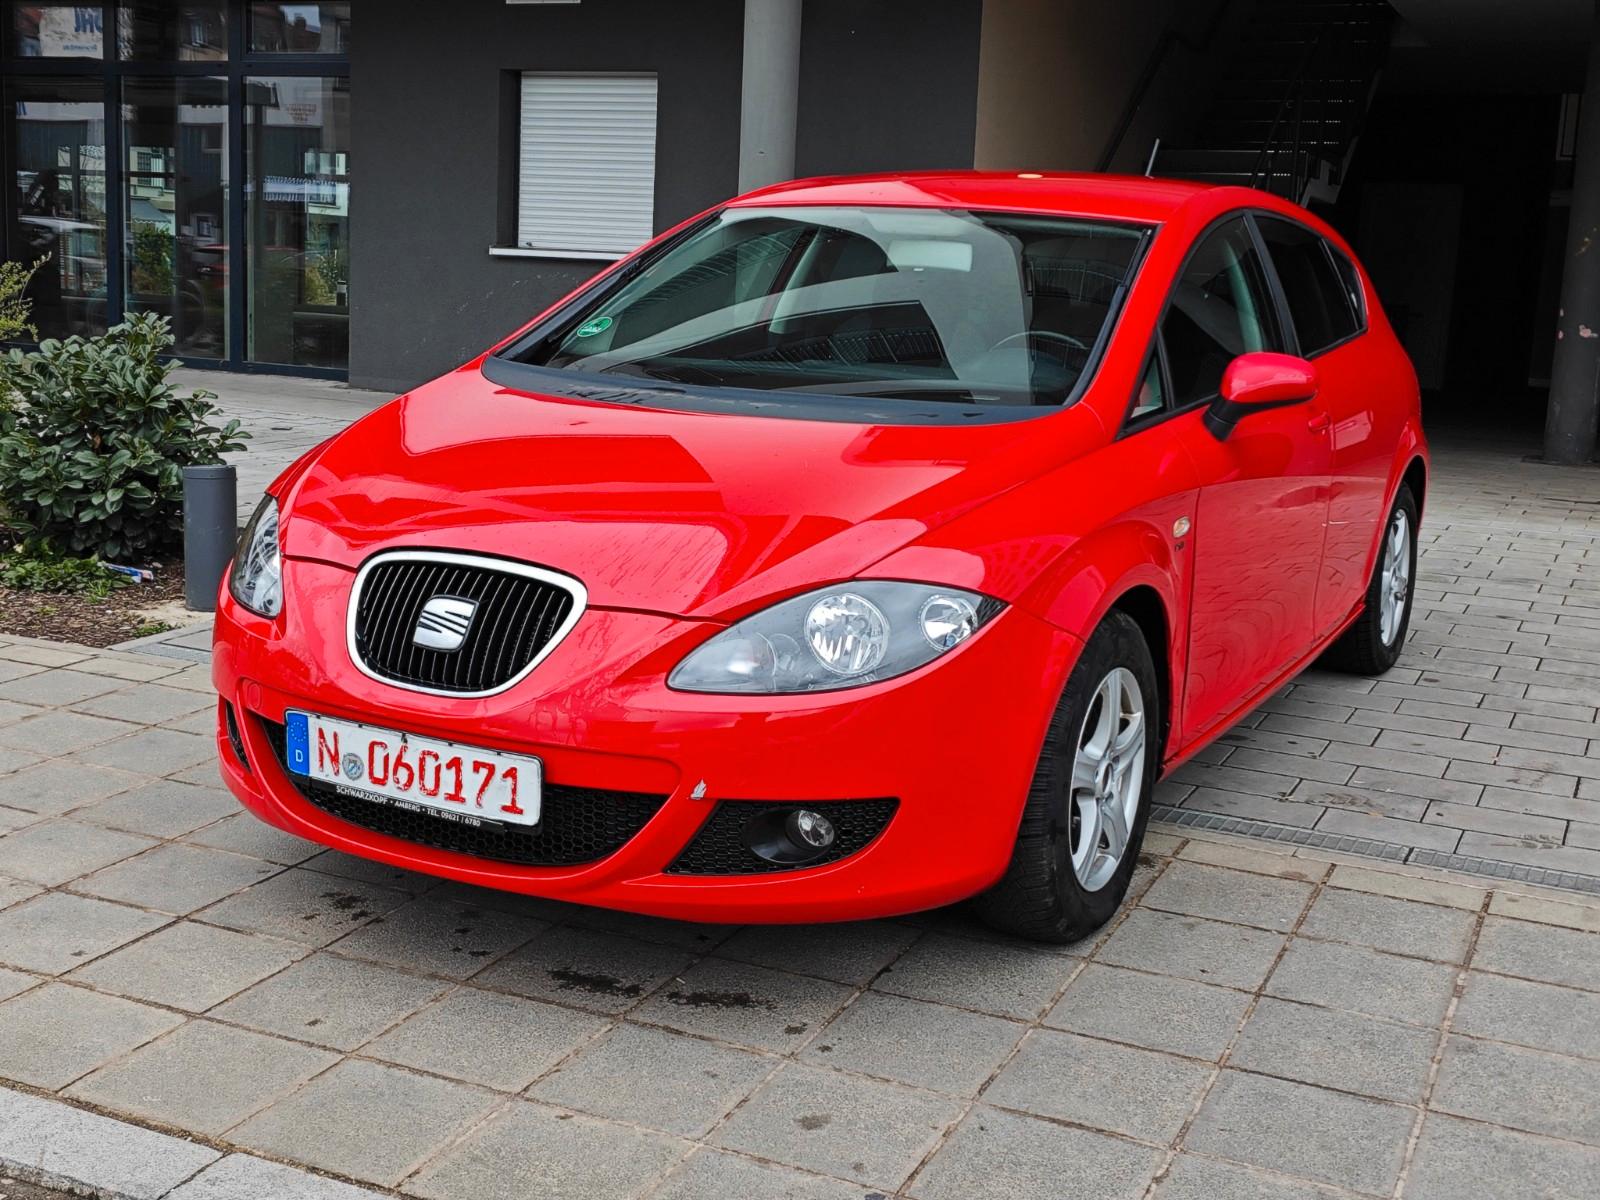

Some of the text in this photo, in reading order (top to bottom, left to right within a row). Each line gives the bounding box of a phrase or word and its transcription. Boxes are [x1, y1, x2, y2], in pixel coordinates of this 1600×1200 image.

[295, 749, 304, 763] D
[318, 727, 524, 815] N 060171
[336, 785, 388, 805] SCHWARZKOPF
[394, 801, 420, 812] AMBERG
[440, 811, 460, 822] 09621
[464, 817, 481, 827] 6780
